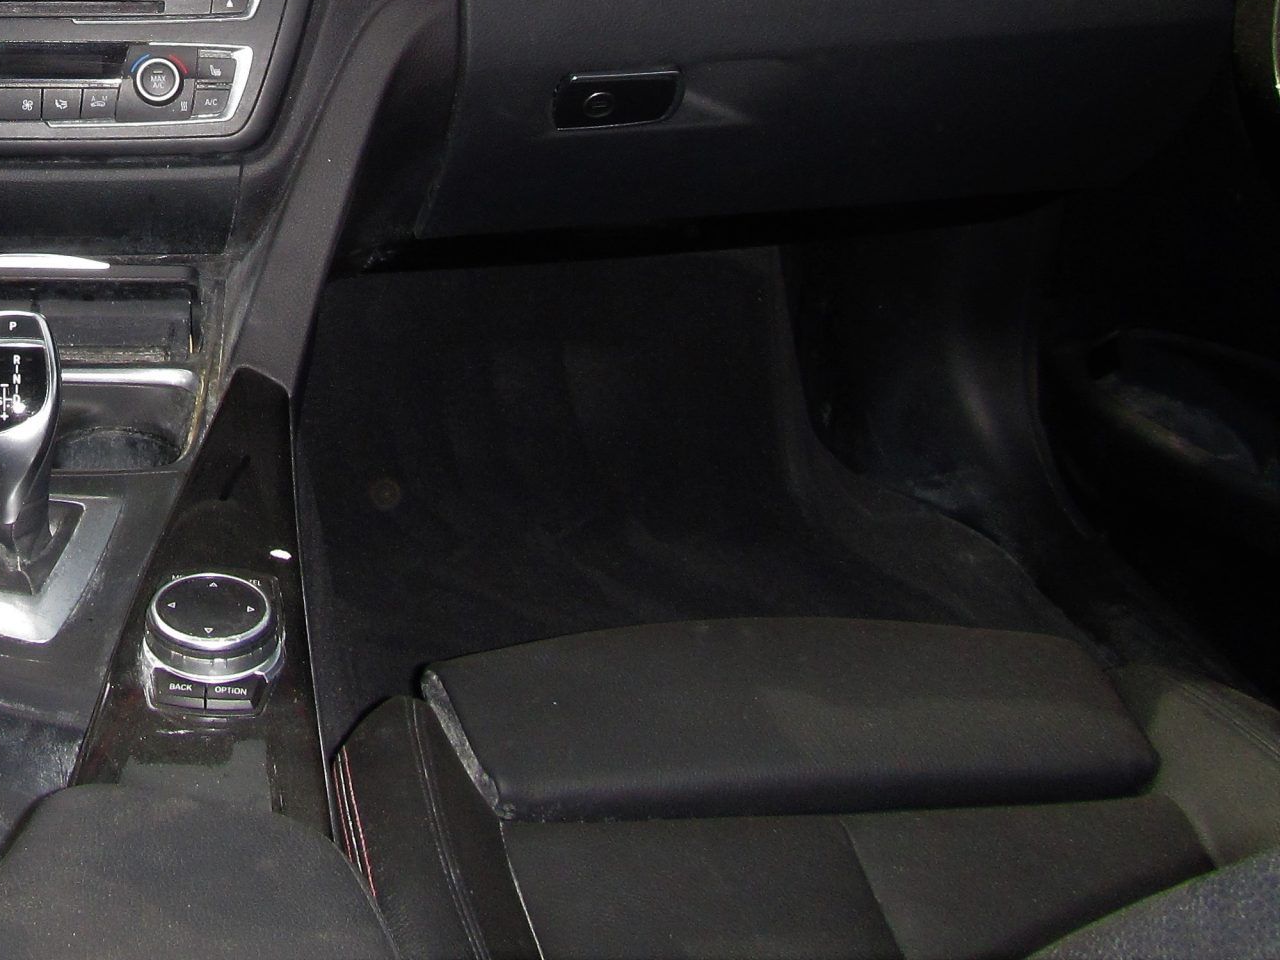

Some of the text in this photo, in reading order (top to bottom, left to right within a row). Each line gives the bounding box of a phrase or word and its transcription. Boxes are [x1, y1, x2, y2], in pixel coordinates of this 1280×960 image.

[150, 75, 167, 83] MAX
[152, 82, 165, 90] A/C
[205, 98, 218, 106] A/C
[9, 321, 17, 331] P
[13, 354, 21, 365] R
[13, 374, 21, 384] N
[169, 683, 247, 695] BACK OPTION
